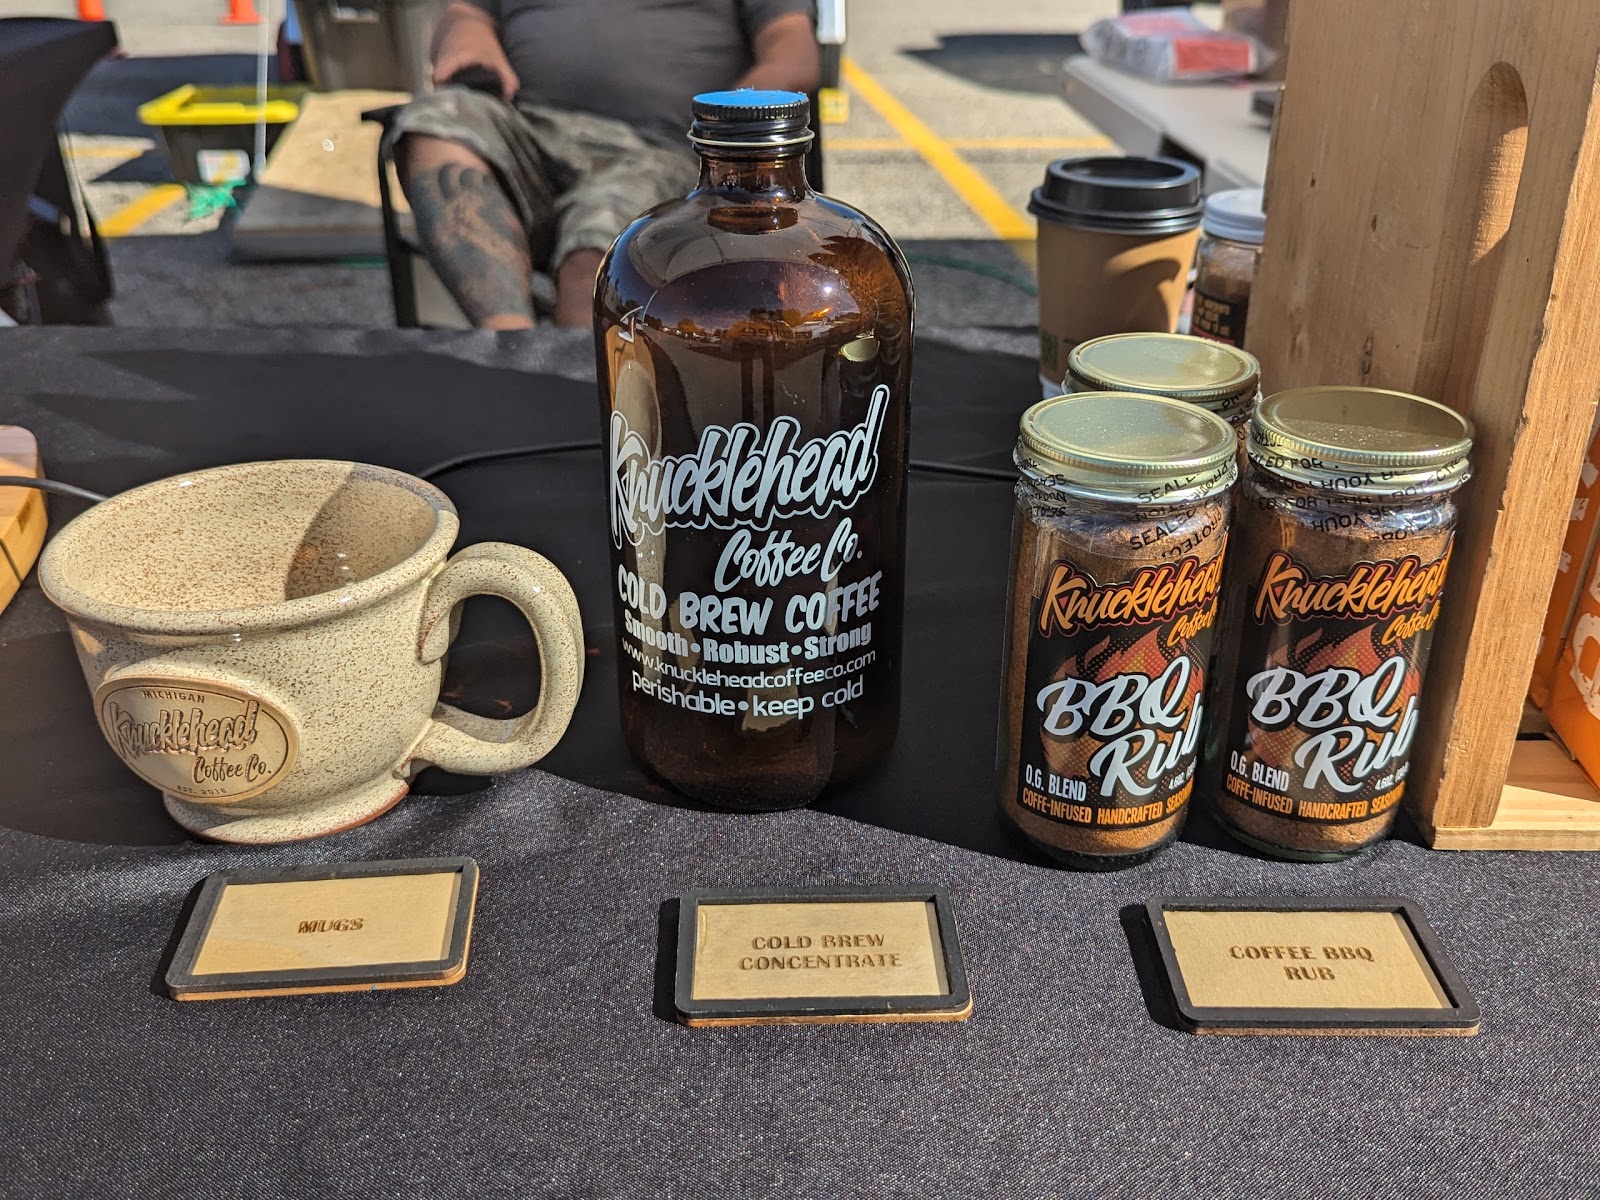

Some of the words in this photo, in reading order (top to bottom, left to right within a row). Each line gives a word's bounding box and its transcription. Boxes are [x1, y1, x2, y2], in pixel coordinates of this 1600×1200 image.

[610, 384, 890, 550] Knucklehead
[714, 528, 822, 593] Coffee
[820, 516, 863, 583] Co.
[617, 563, 668, 621] COLD
[679, 591, 774, 636] BREW
[785, 570, 883, 634] COFFEE
[1038, 540, 1227, 638] Knucklehead
[1254, 540, 1453, 626] Knucklehead
[624, 609, 689, 658] Smooth
[703, 638, 790, 665] Robust
[804, 622, 872, 660] Strong
[622, 637, 876, 690] www.knuckleheadcoffeeco.com
[142, 690, 205, 704] MICHIGAN
[632, 670, 736, 717] perishable
[753, 694, 814, 720] keep
[821, 674, 864, 709] cold
[1036, 655, 1191, 737] BBQ
[1246, 655, 1406, 729] BBQ
[110, 700, 260, 760] Knucklehead
[1090, 692, 1204, 797] Rub
[1294, 694, 1419, 793] Rub
[193, 756, 244, 785] Coffee
[245, 753, 273, 784] Co.
[201, 787, 228, 796] 2018
[1048, 773, 1087, 802] BLEND
[1251, 763, 1290, 792] BLEND
[1097, 801, 1163, 826] HANDCRAFTED
[1165, 775, 1195, 814] SEASON
[1298, 800, 1368, 820] HANDCRAFTED
[1370, 780, 1406, 814] SEASON
[297, 917, 365, 934] MUGS
[751, 935, 813, 951] COLD
[821, 933, 886, 949] BREW
[738, 952, 904, 971] CONCENTRATE
[1228, 945, 1318, 960] COFFEE
[1322, 945, 1376, 963] BBQ
[1283, 966, 1336, 982] RUB
